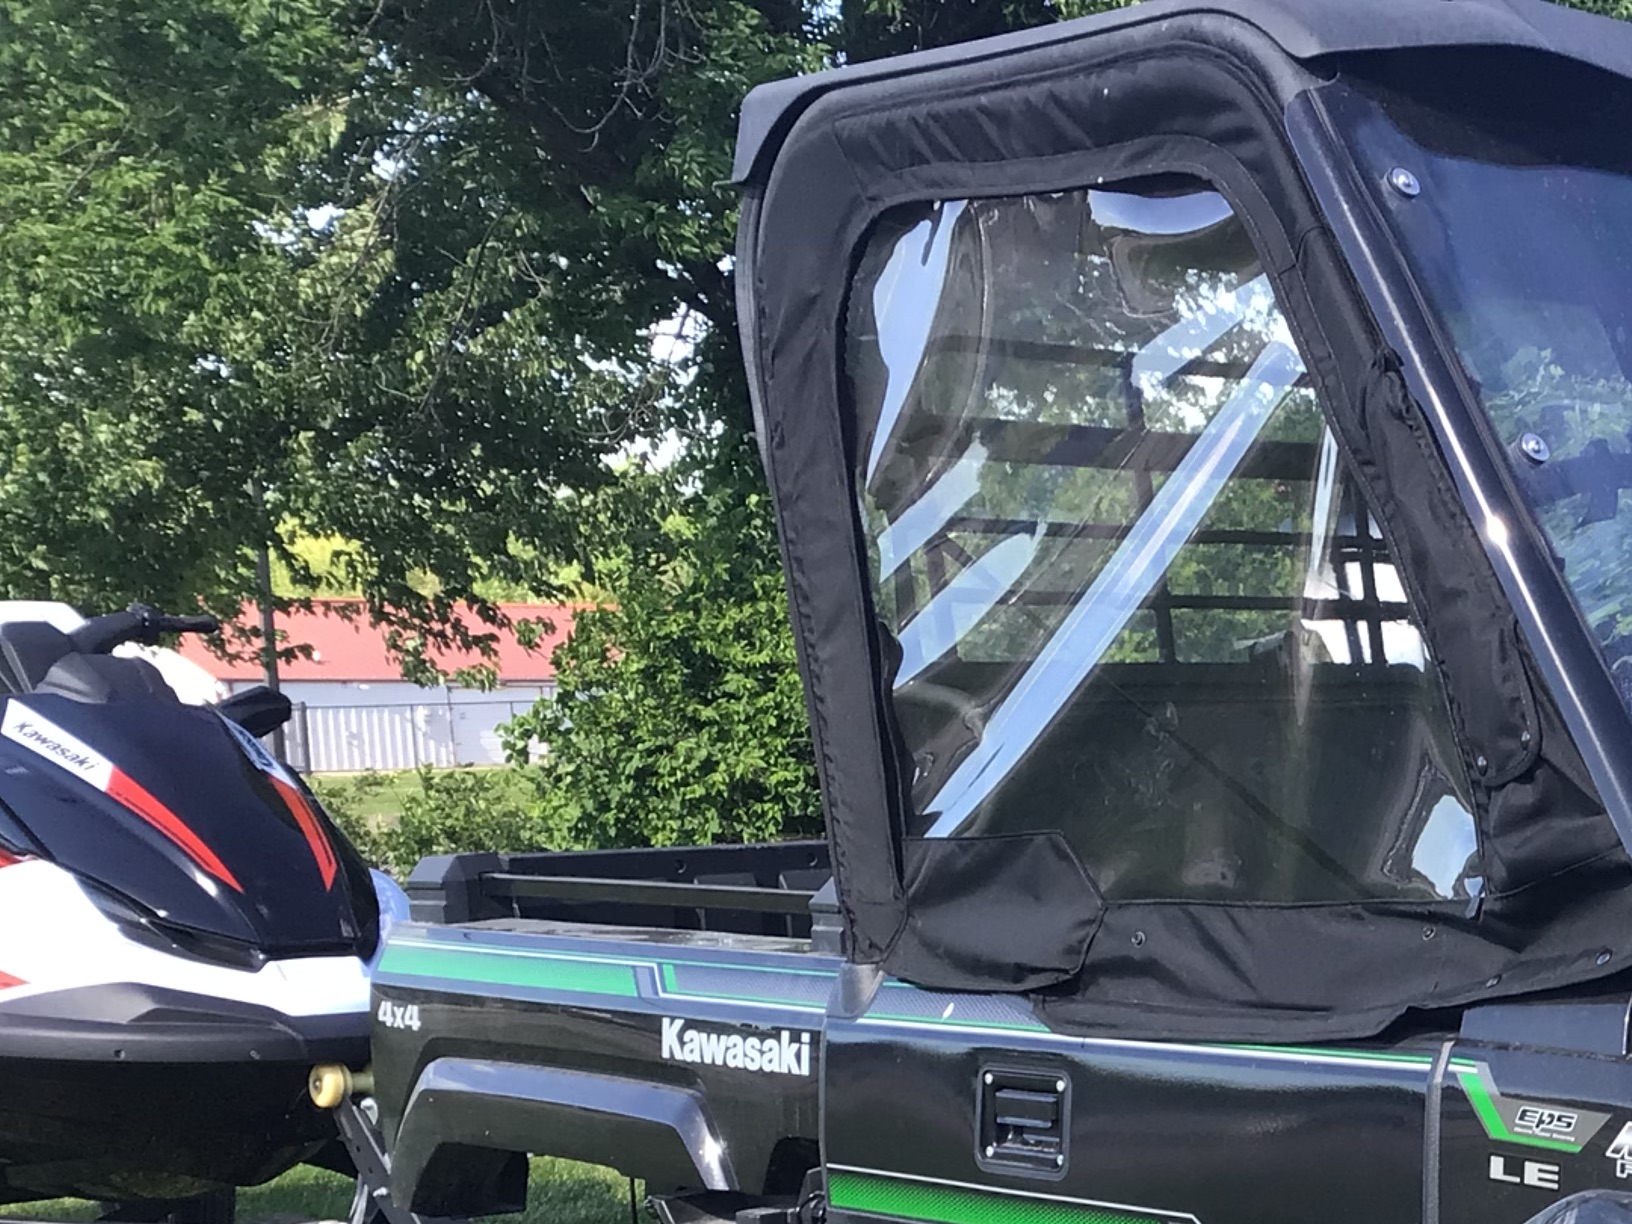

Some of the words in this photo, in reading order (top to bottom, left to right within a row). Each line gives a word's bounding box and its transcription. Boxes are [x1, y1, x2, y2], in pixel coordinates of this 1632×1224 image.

[13, 720, 101, 772] Kawasaki
[378, 1000, 422, 1032] 4x4
[661, 1017, 811, 1077] Kawasaki
[1489, 1155, 1560, 1190] LE
